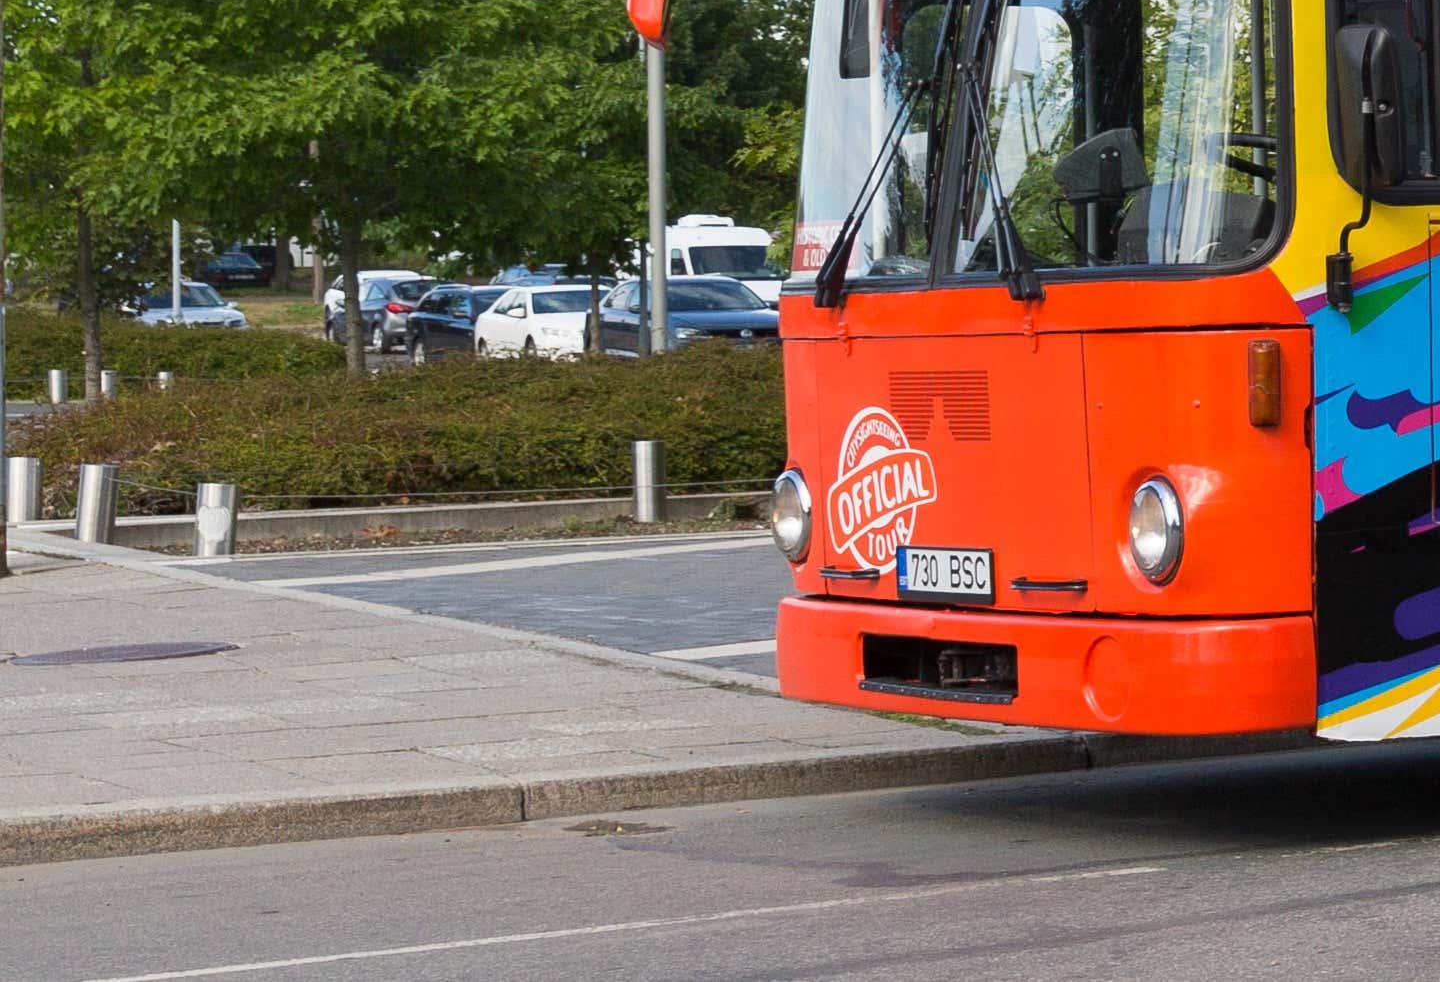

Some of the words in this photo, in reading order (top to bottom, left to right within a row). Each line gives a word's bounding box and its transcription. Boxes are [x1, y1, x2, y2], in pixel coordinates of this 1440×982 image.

[846, 419, 901, 468] CITYSIGHTSEEING
[838, 458, 930, 535] OFFICIAL
[867, 517, 909, 561] TOUR
[911, 554, 939, 587] 730
[950, 555, 987, 589] BSC
